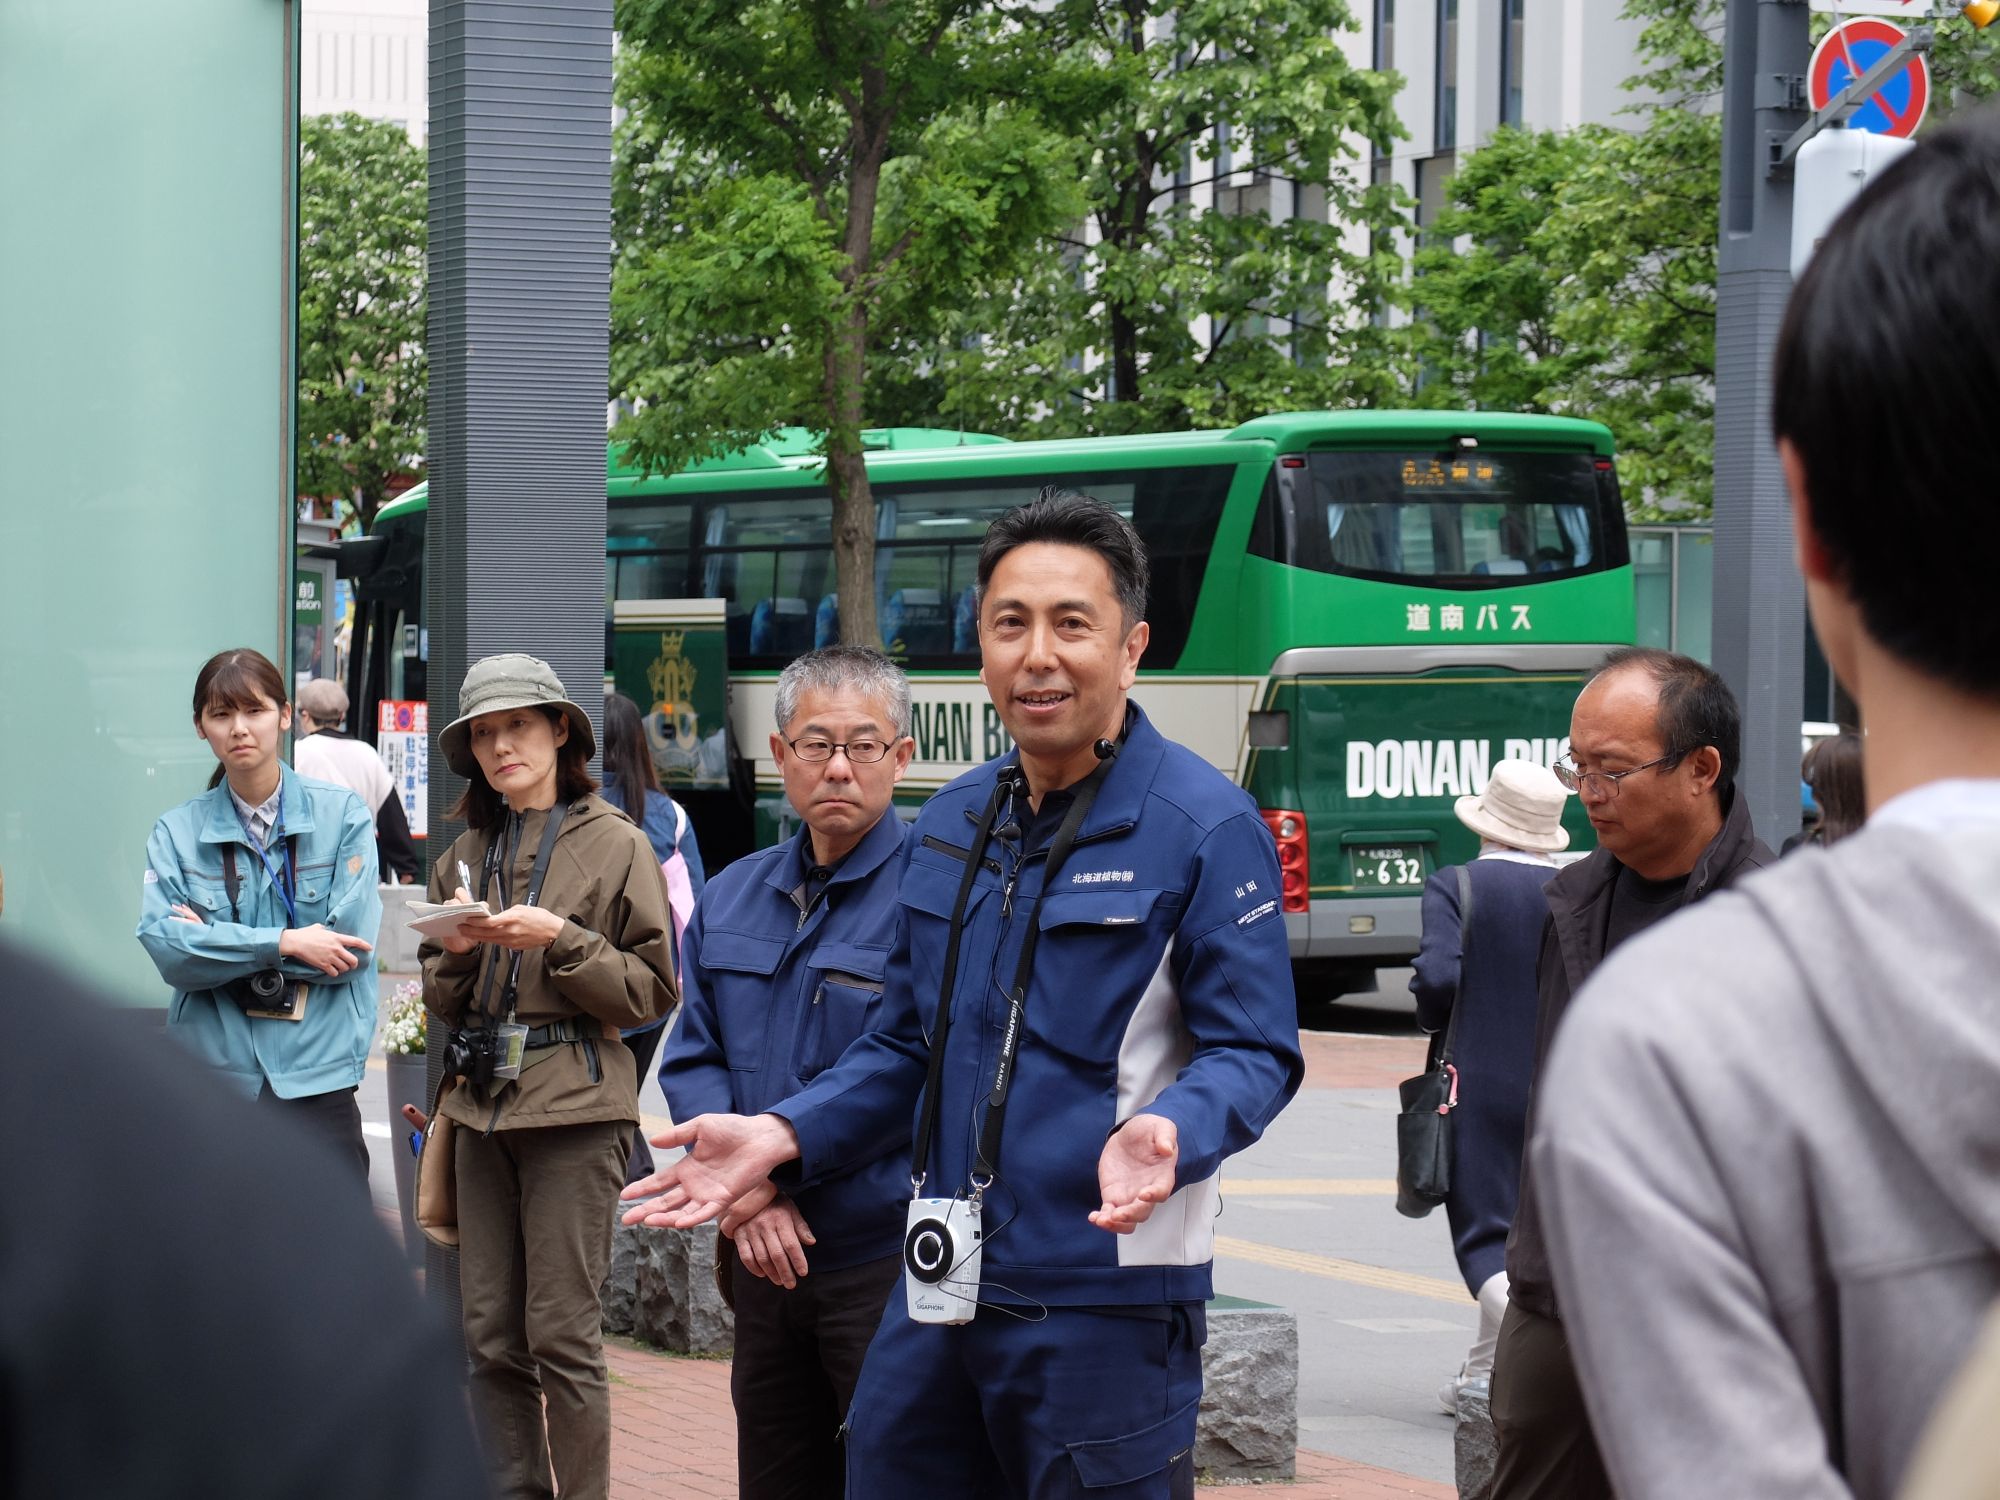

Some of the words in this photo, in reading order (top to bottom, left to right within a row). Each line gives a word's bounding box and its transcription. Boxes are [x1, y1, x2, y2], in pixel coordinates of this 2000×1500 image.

[1406, 604, 1532, 631] 道南バス
[1346, 739, 1490, 798] DONAN
[1235, 880, 1258, 899] 山田
[996, 1062, 1006, 1091] NANZU
